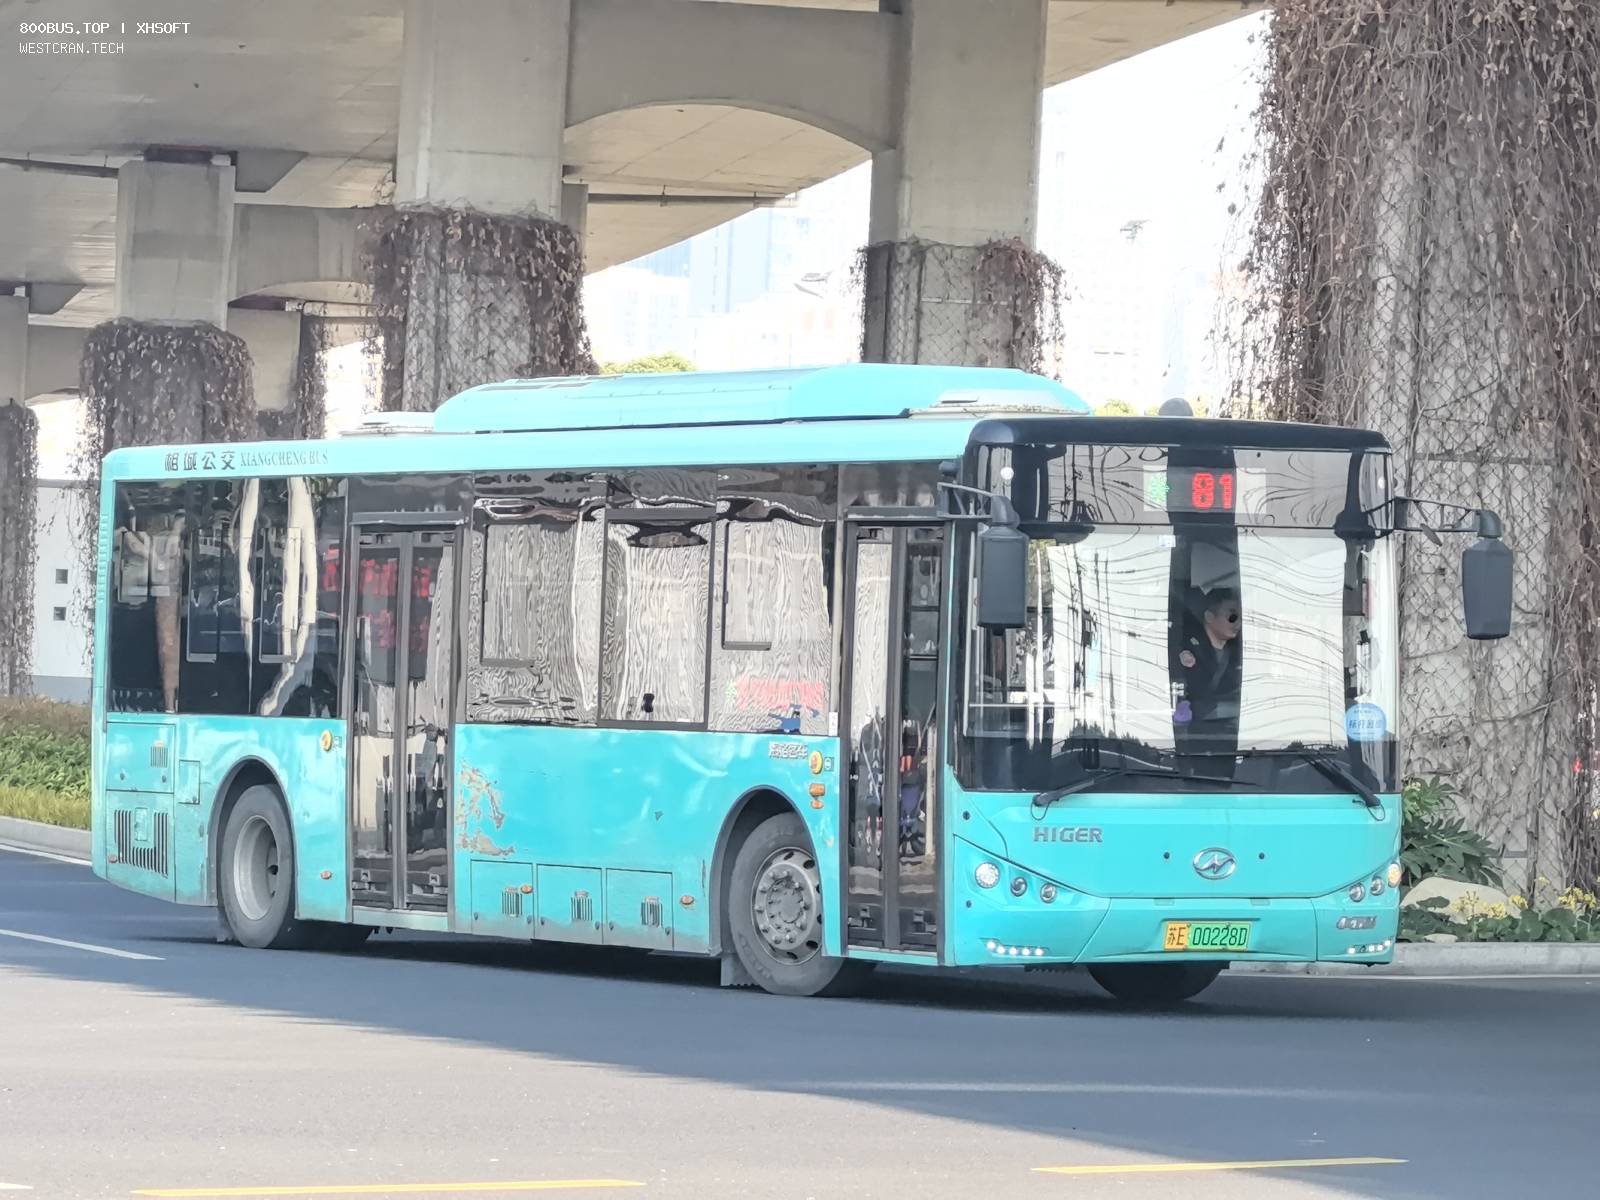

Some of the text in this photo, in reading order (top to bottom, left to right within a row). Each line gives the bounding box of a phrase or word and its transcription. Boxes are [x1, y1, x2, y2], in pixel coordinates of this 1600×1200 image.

[240, 451, 306, 467] XIANGCHENG
[1192, 472, 1233, 510] 81
[1033, 826, 1103, 843] HIGER
